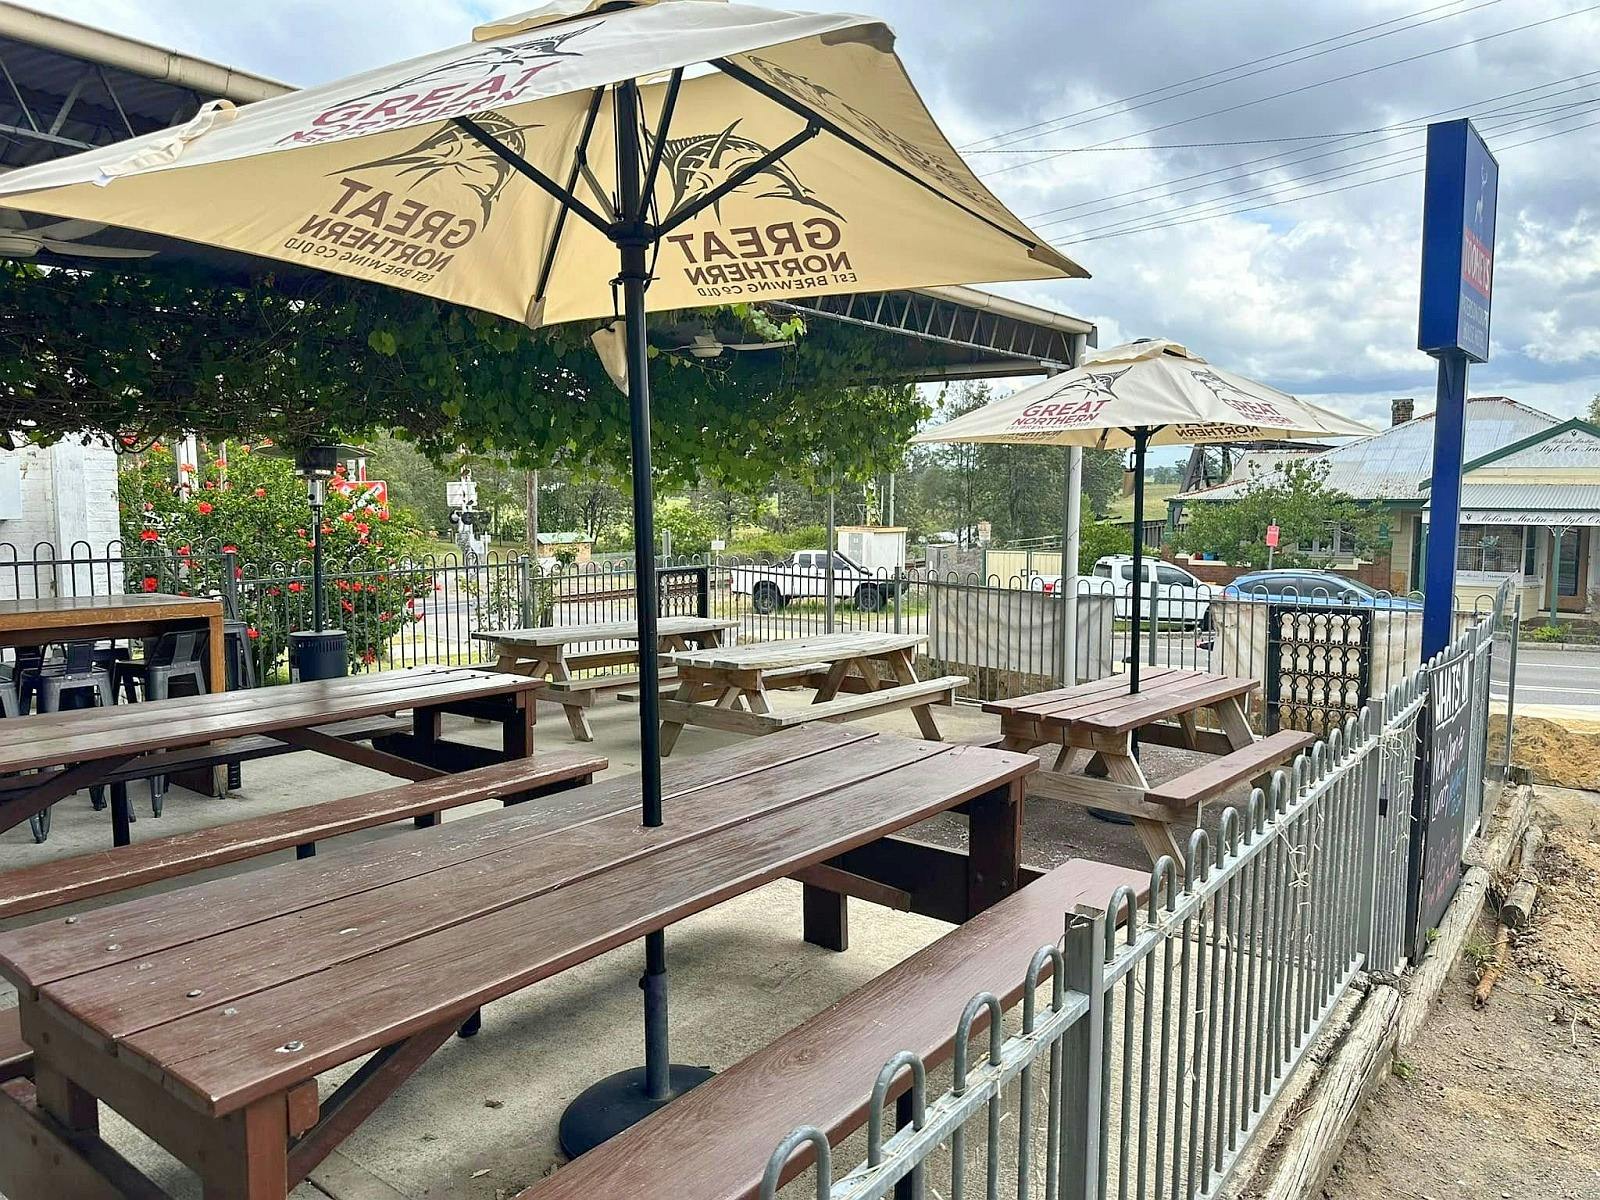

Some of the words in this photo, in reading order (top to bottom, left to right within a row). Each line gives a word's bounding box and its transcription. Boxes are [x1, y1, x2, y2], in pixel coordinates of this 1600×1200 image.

[312, 60, 563, 127] GREAT
[1022, 399, 1113, 418] GREAT
[1221, 397, 1282, 417] GREAT
[1011, 412, 1100, 427] NORTHERN
[1433, 662, 1460, 726] WHATS
